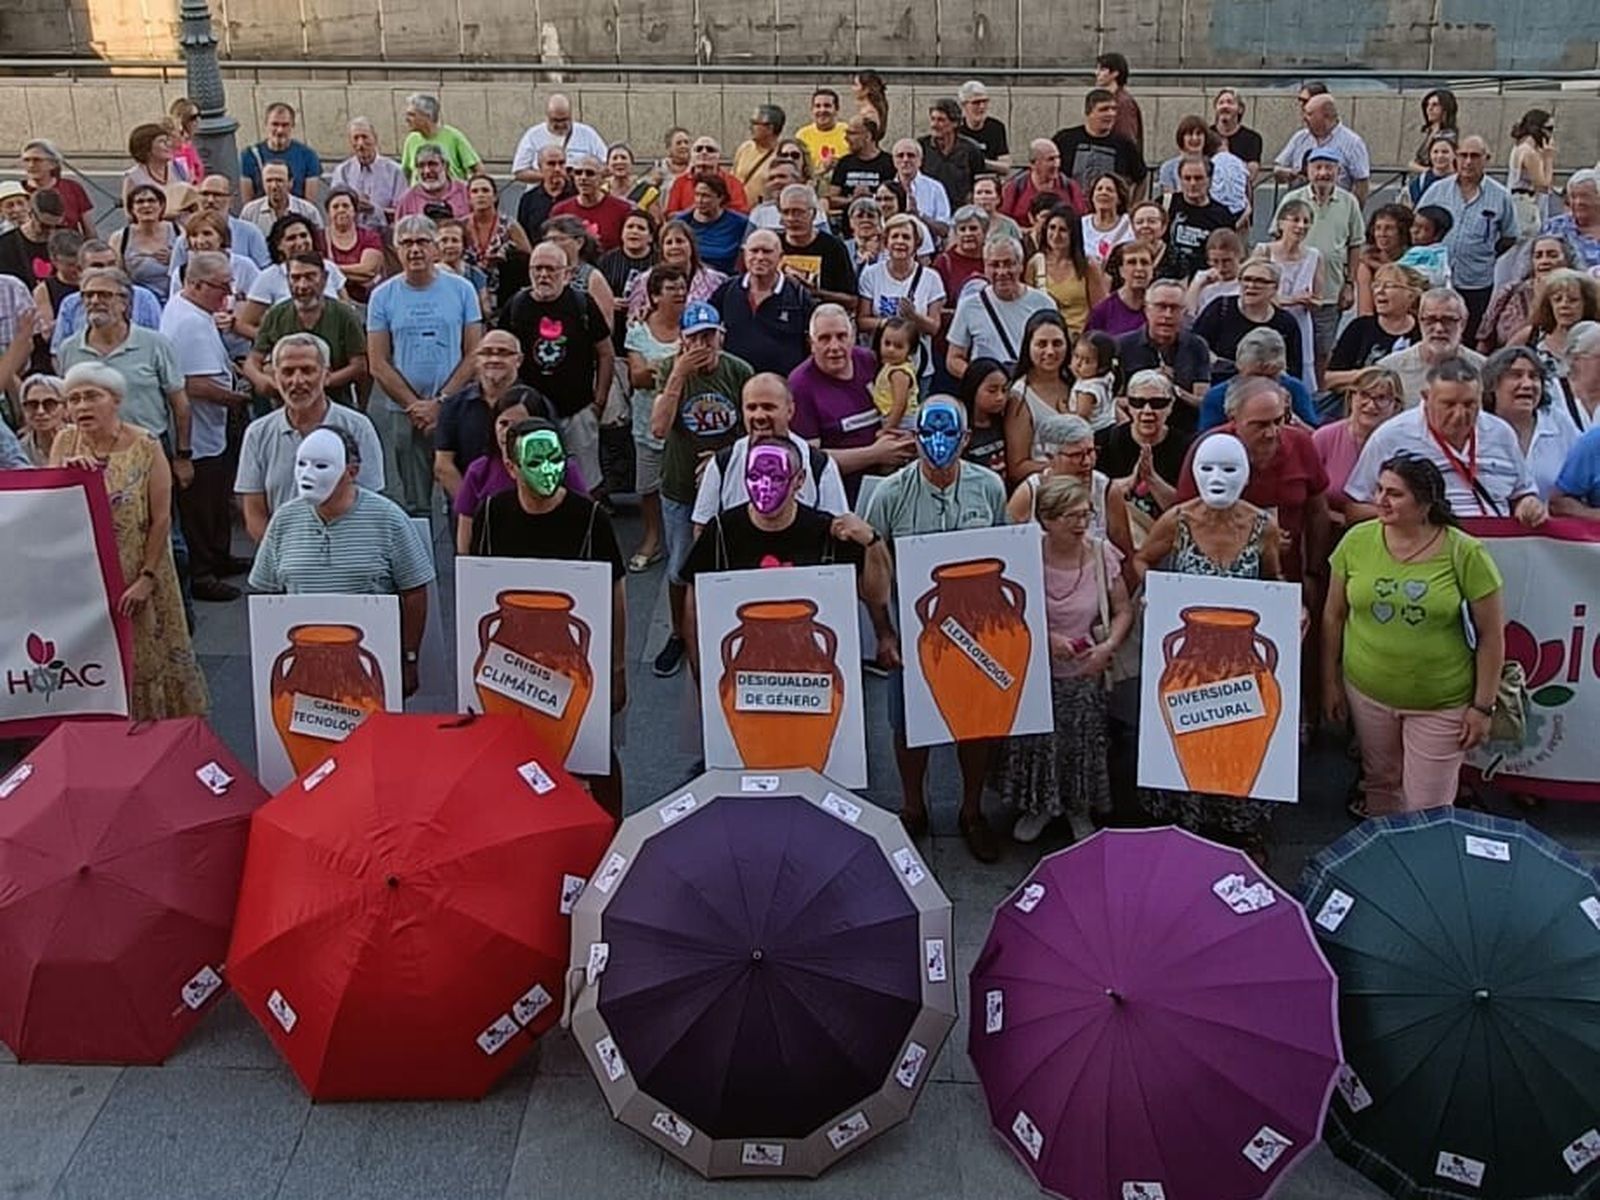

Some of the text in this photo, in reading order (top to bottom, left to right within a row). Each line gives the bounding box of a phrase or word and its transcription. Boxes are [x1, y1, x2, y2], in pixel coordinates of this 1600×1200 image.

[502, 652, 553, 682] CRISIS
[481, 664, 559, 709] CLIMÁTICA
[737, 673, 831, 689] DESIGUALDAD
[1167, 679, 1254, 708] DIVERSIDAD
[313, 700, 361, 717] CAMBIO
[745, 690, 822, 707] DE GÉNERO
[1179, 701, 1253, 727] CULTURAL
